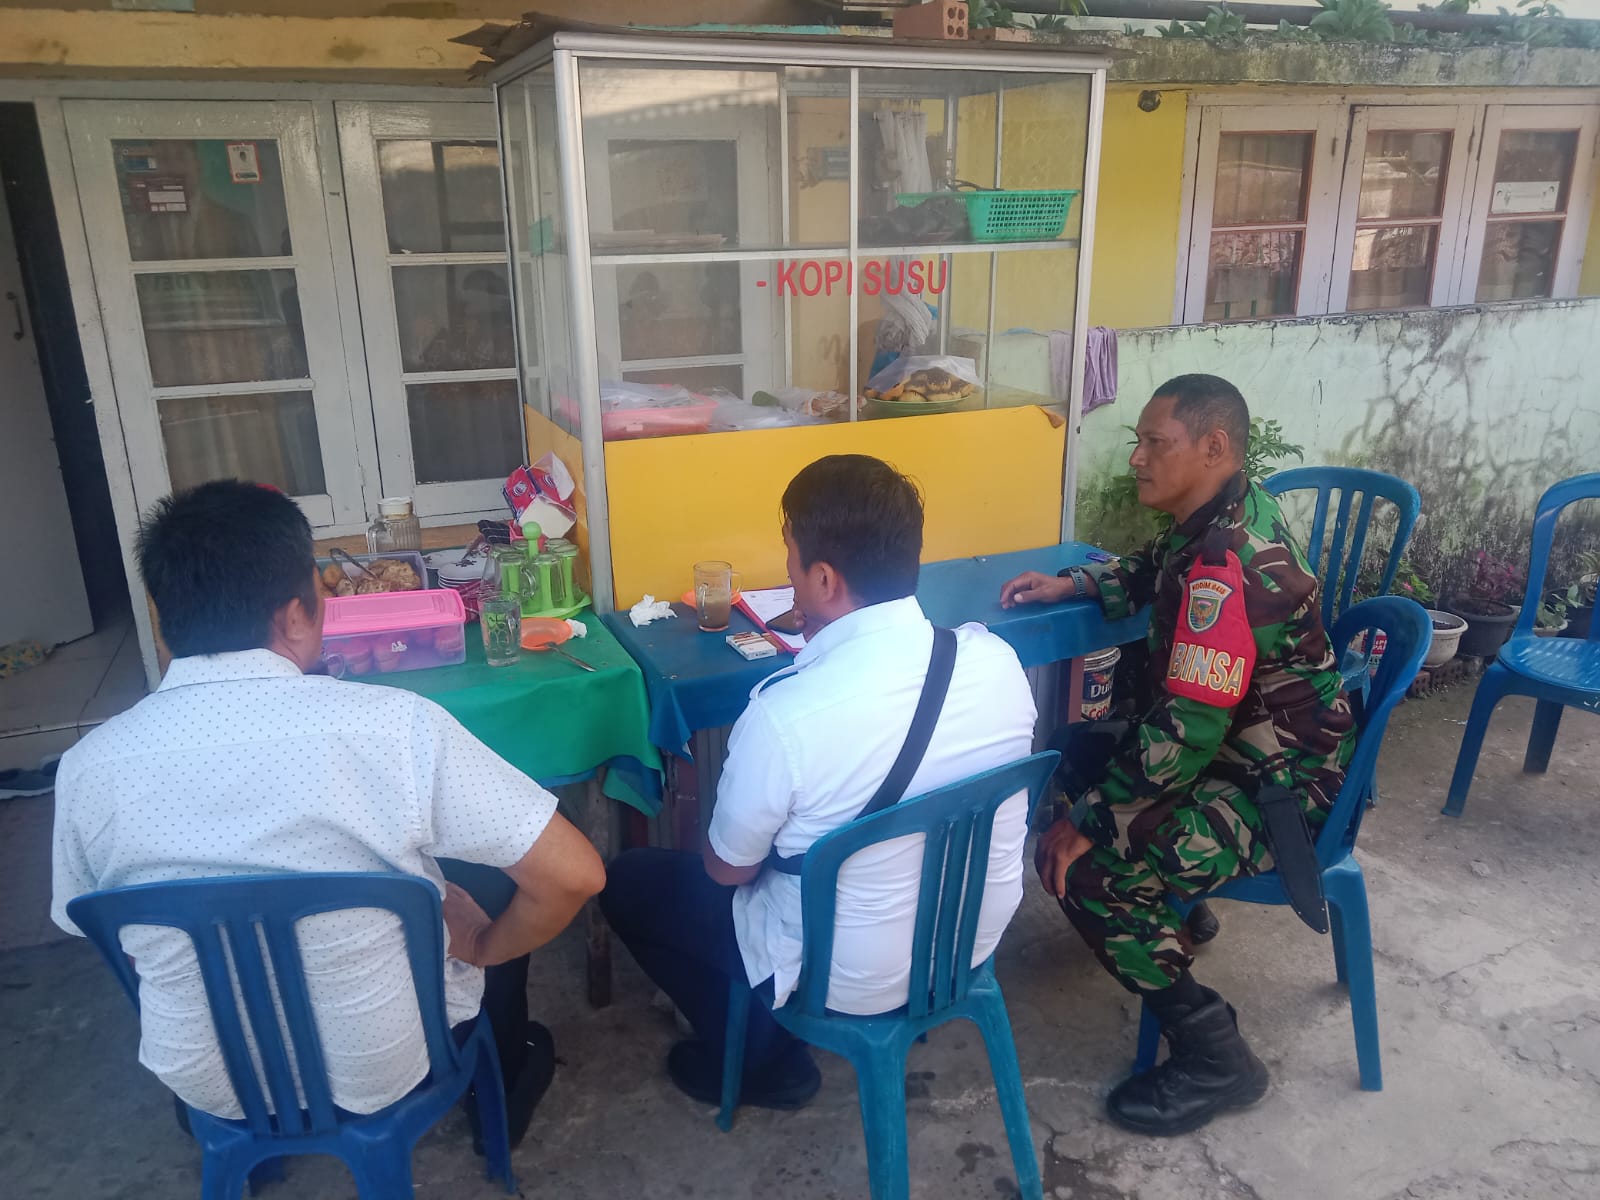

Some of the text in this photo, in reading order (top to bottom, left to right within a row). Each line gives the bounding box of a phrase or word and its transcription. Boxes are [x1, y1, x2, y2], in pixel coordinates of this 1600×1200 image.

[777, 260, 853, 297] KOPI
[863, 260, 947, 296] SUSU
[1167, 642, 1246, 697] BINSA
